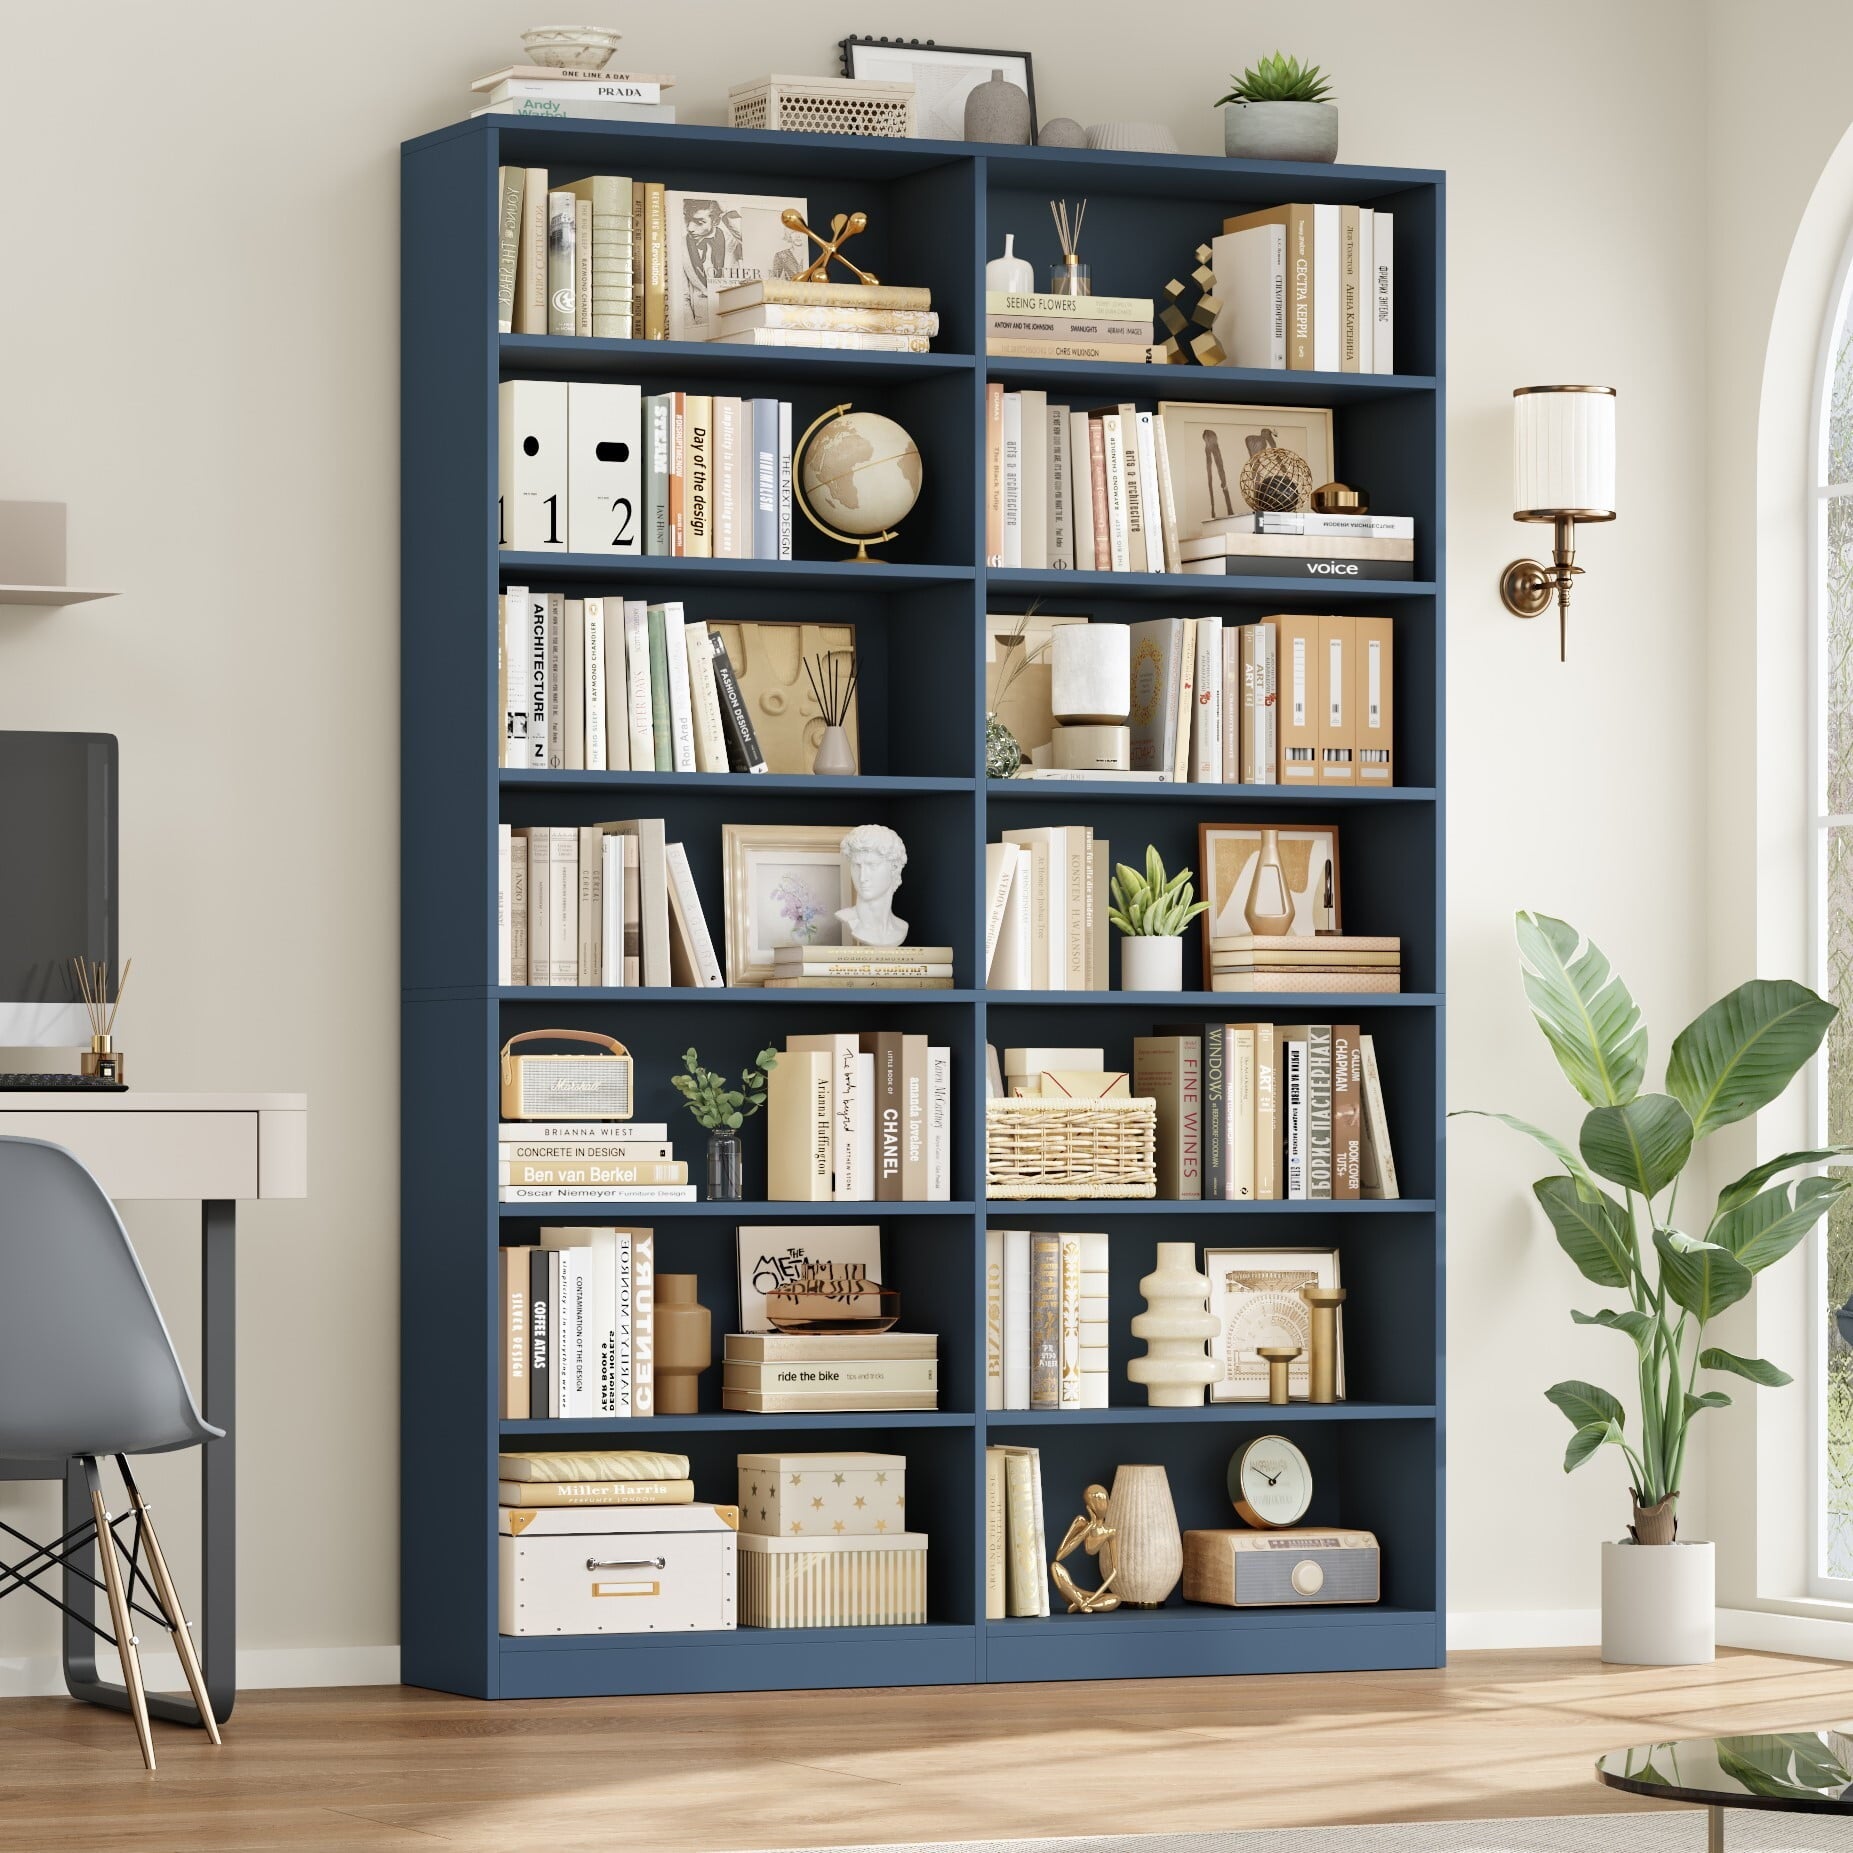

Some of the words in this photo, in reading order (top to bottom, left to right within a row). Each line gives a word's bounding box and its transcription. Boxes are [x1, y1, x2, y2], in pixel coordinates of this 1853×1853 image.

[583, 71, 602, 79] LINE
[524, 99, 560, 113] Andy
[598, 87, 642, 97] PRADA
[650, 242, 660, 286] Revolution
[1296, 259, 1307, 300] СЕСТРА
[1006, 297, 1036, 310] SEEING
[1039, 298, 1077, 311] FLOWERS
[1070, 325, 1098, 333] SWANLIGHTS
[1296, 303, 1307, 339] КЕРРИ
[1055, 347, 1071, 356] CHRIS
[1072, 348, 1100, 357] WILKINSON
[690, 427, 707, 451] Day
[1007, 441, 1017, 458] arts
[694, 455, 707, 469] of
[782, 455, 791, 476] THE
[1126, 450, 1136, 467] arts
[694, 471, 707, 491] the
[760, 452, 774, 512] MINIMALISM
[782, 479, 791, 509] NEXT
[1007, 473, 1017, 526] architecture
[1128, 481, 1141, 532] architecture
[543, 494, 564, 544] 1
[612, 498, 635, 546] 2
[690, 496, 707, 537] design
[782, 512, 791, 556] DESIGN
[1306, 560, 1359, 575] voice
[534, 604, 544, 722] ARCHITECTURE
[1245, 663, 1254, 689] ART
[1256, 663, 1264, 688] ART
[719, 668, 739, 710] FASHION
[734, 708, 752, 742] DESIGN
[679, 717, 689, 742] Arad
[682, 744, 692, 767] Ron
[1072, 854, 1080, 903] KONSTEN
[934, 1059, 946, 1082] Karen
[1208, 1028, 1222, 1101] WINDOWS
[1259, 1065, 1271, 1092] ART
[1335, 1038, 1348, 1092] CHAPMAN
[1351, 1049, 1360, 1082] CALLUM
[1183, 1059, 1198, 1103] FINE
[1311, 1032, 1331, 1130] ПАСТЕРНАК
[817, 1079, 829, 1117] Arianna
[909, 1077, 922, 1117] amanda
[931, 1085, 946, 1129] McCartney
[545, 1128, 595, 1136] BRIANNA
[601, 1128, 633, 1136] WIEST
[883, 1109, 898, 1179] CHANEL
[909, 1119, 922, 1162] lovelace
[1183, 1113, 1198, 1178] WINES
[517, 1148, 573, 1157] CONCRETE
[576, 1148, 585, 1157] IN
[588, 1148, 625, 1157] DESIGN
[814, 1121, 830, 1175] Huffington
[1311, 1136, 1331, 1190] БОРИС
[1348, 1140, 1359, 1163] BOOK
[524, 1166, 555, 1182] Ben
[558, 1170, 585, 1182] van
[590, 1166, 637, 1182] Berkel
[1337, 1152, 1347, 1177] TUTS+
[1348, 1164, 1359, 1189] COVER
[516, 1189, 552, 1197] Oscar
[558, 1189, 616, 1198] Niemeyer
[787, 1248, 805, 1258] THE
[512, 1293, 523, 1331] SILVER
[534, 1301, 547, 1337] COFFEE
[512, 1337, 523, 1378] DESIGN
[534, 1339, 547, 1369] ATLAS
[576, 1339, 583, 1349] OF
[778, 1371, 797, 1382] ride
[800, 1371, 816, 1381] the
[818, 1371, 840, 1381] bike
[847, 1373, 857, 1381] tips
[558, 1485, 610, 1496] Miller
[614, 1484, 667, 1495] Harris
